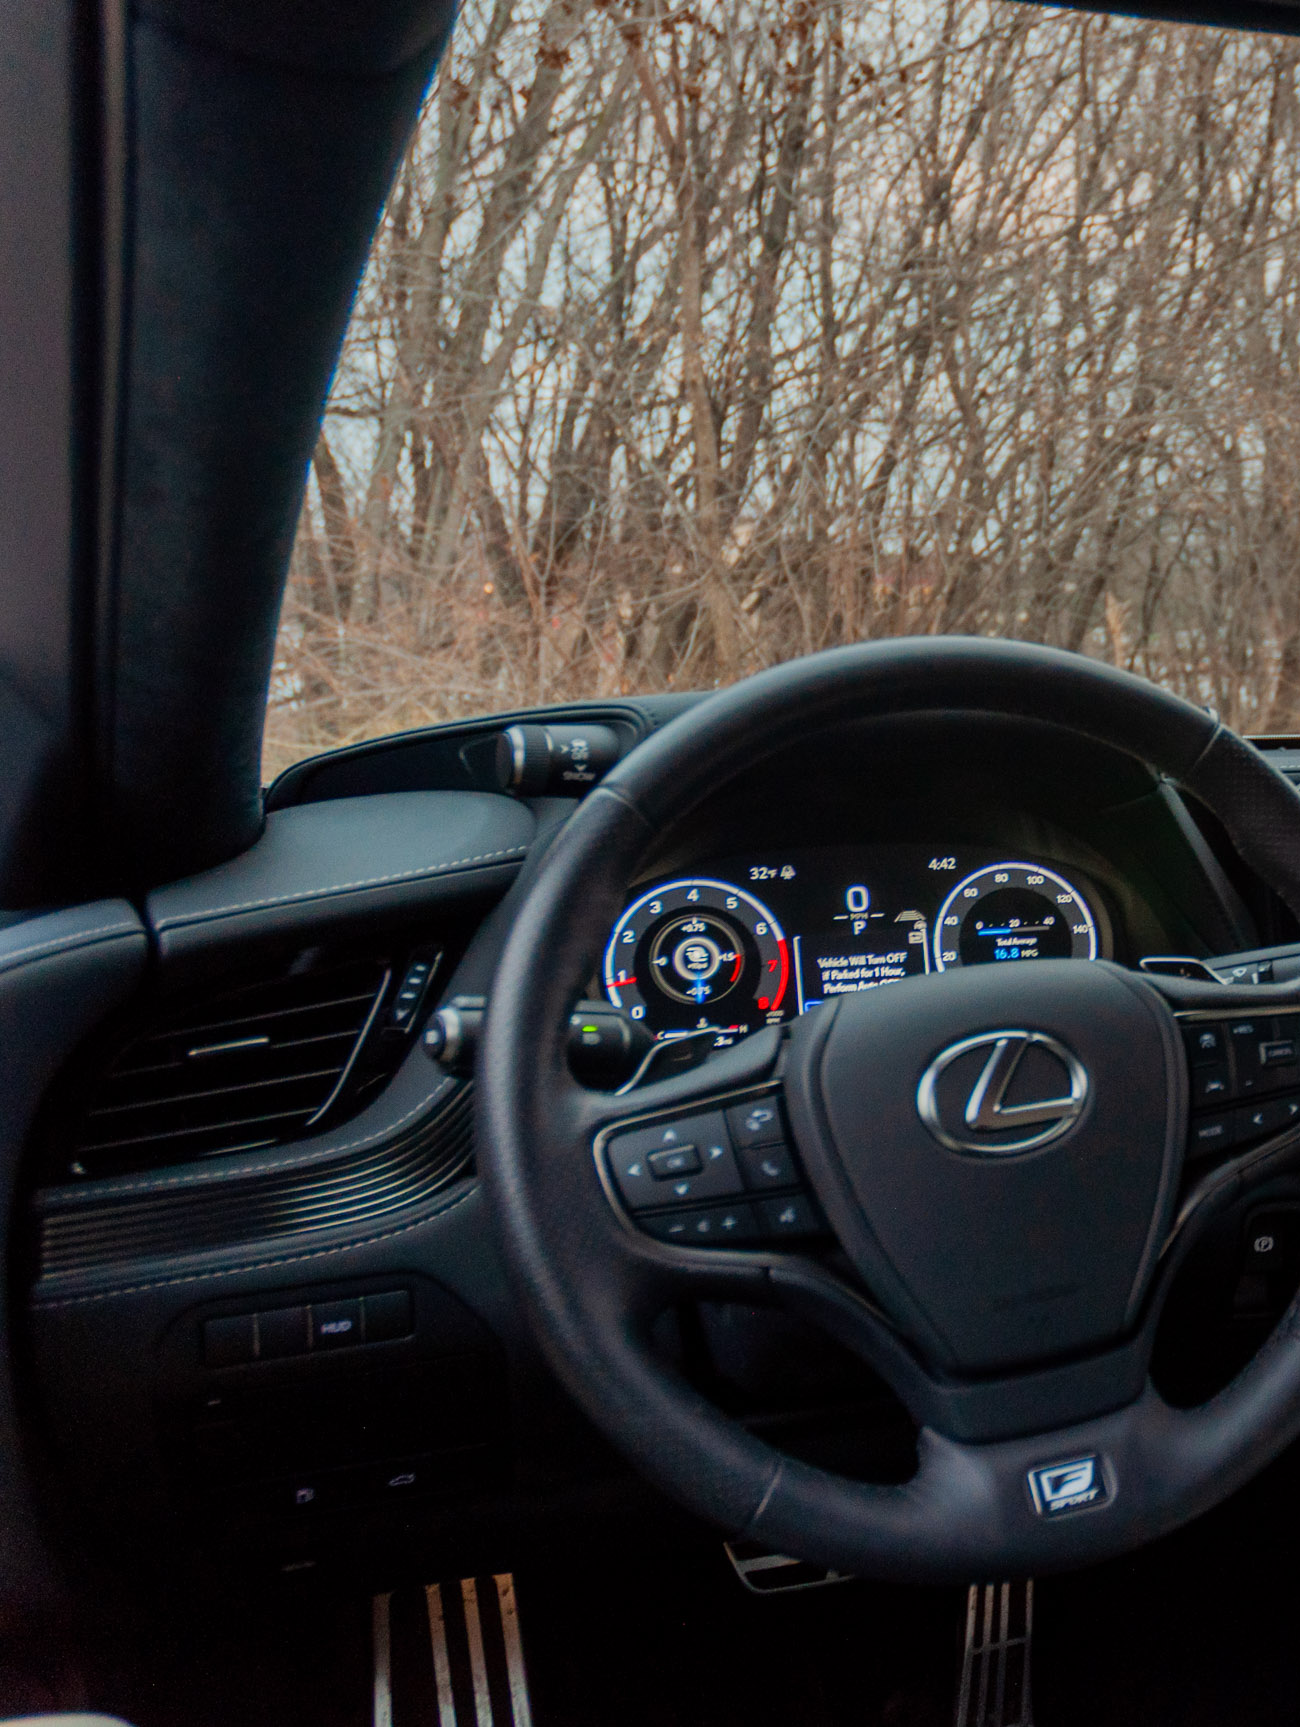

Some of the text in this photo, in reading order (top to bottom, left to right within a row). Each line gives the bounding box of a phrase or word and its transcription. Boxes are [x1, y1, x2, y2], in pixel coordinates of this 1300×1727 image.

[928, 857, 957, 870] 4:42
[994, 873, 1009, 883] 80
[1026, 875, 1044, 885] 100
[687, 889, 699, 901] 4
[846, 885, 869, 912] 0
[964, 888, 978, 898] 60
[1056, 894, 1073, 904] 120
[650, 901, 662, 914] 3
[726, 897, 738, 909] 5
[944, 916, 959, 926] 40
[975, 917, 1055, 930] 0 20 40
[756, 922, 768, 935] 6
[853, 921, 867, 935] P
[1073, 924, 1089, 934] 140
[622, 931, 635, 944] 2
[942, 951, 957, 961] 20
[994, 947, 1019, 960] 16.8
[767, 960, 778, 973] 7
[817, 952, 907, 969] Vehicle Will Turn OFF
[617, 970, 626, 982] 1
[831, 968, 860, 981] Parked
[860, 968, 874, 979] for
[874, 968, 880, 977] 1
[823, 982, 857, 994] Perform
[758, 997, 769, 1009] 8
[631, 1006, 645, 1019] 0
[739, 1024, 748, 1034] H
[321, 1320, 352, 1335] HUD
[1050, 1488, 1100, 1512] SPORT
